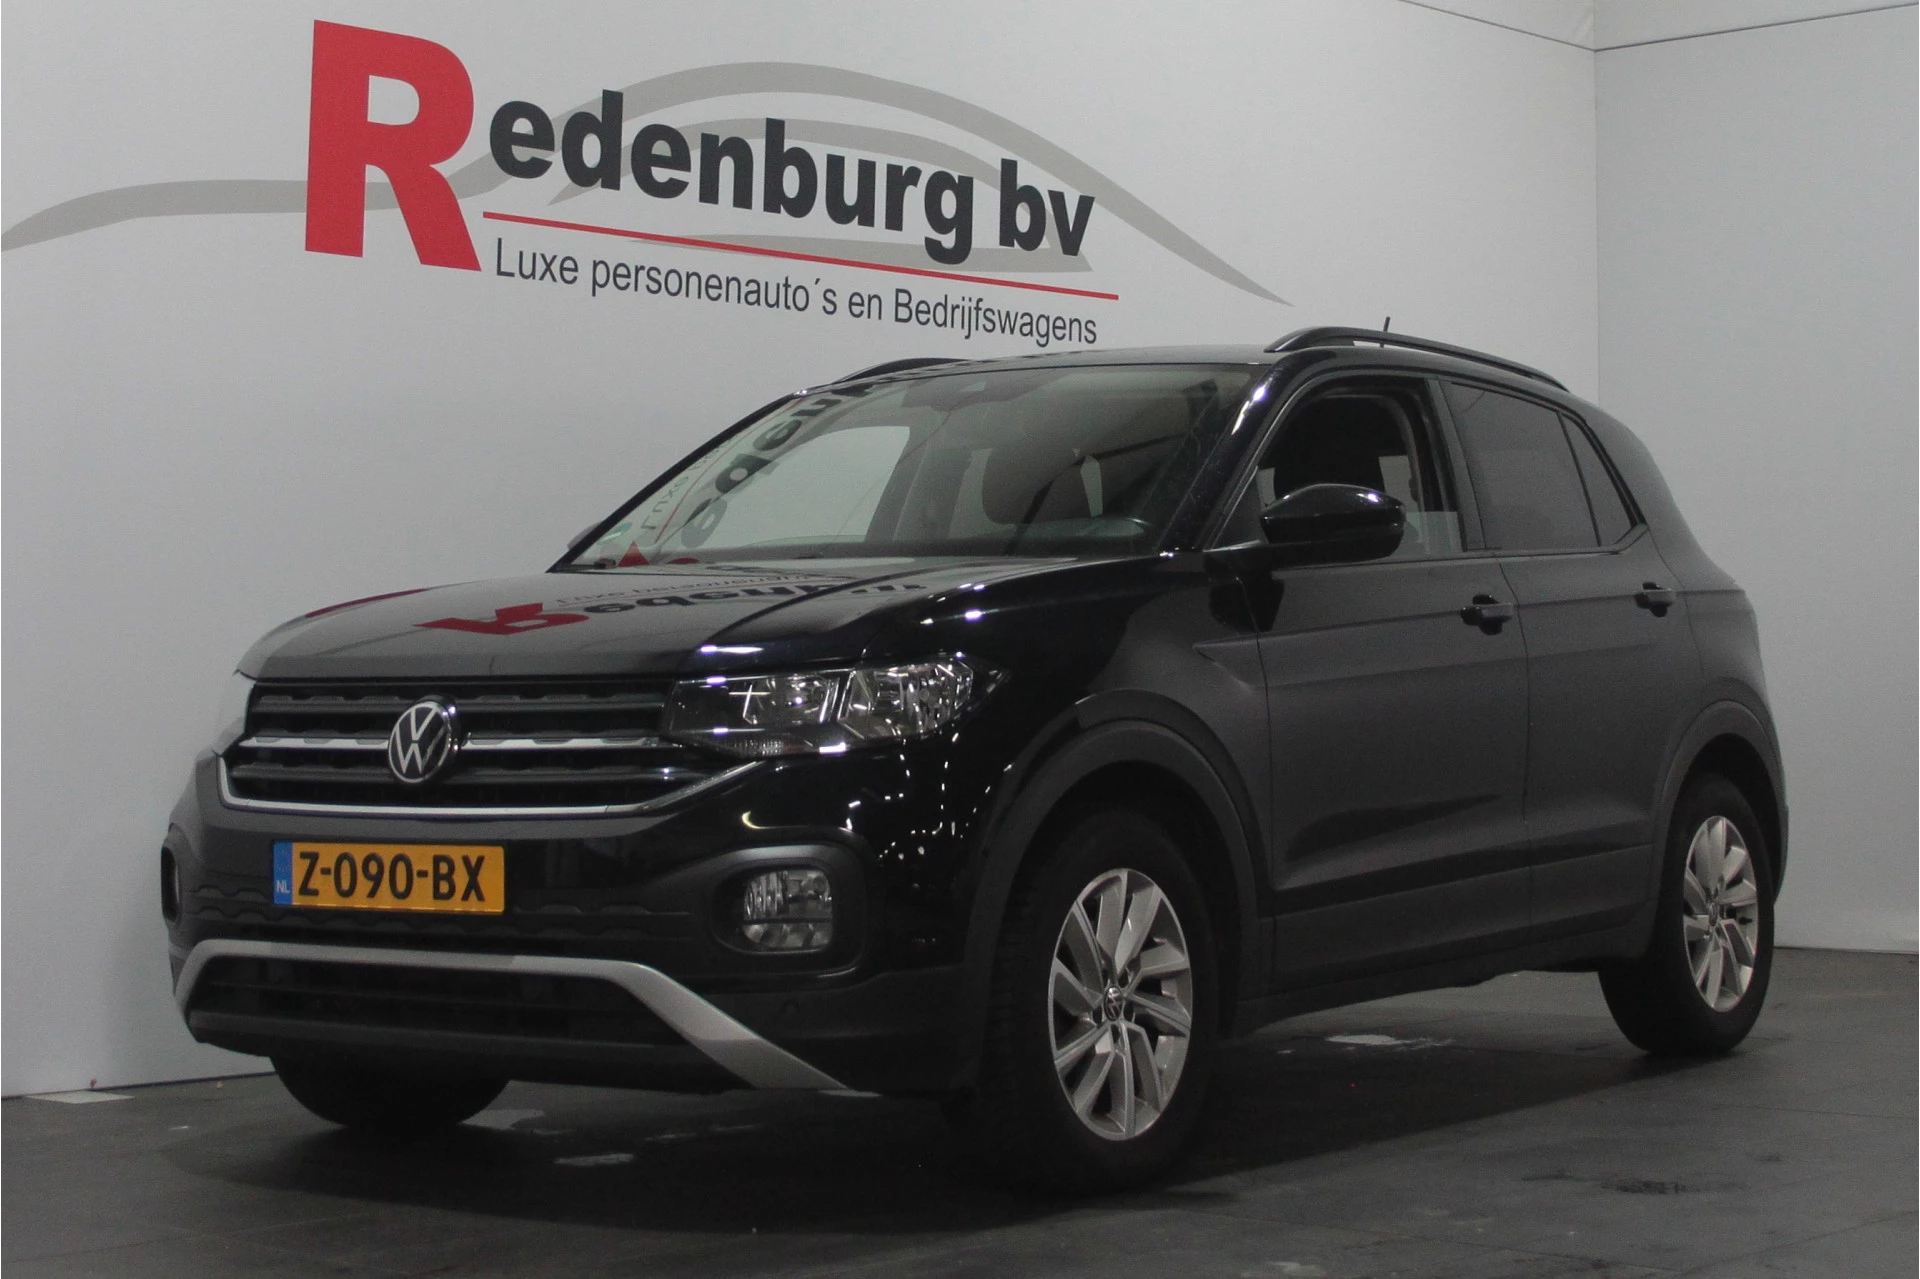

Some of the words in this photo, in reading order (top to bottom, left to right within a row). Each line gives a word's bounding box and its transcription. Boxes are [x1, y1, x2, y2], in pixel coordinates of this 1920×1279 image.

[306, 20, 973, 271] Redenburg
[1000, 159, 1095, 256] bv
[497, 238, 578, 284] Luxe
[849, 292, 882, 320] en
[895, 289, 1096, 347] Bedrijfswagens
[276, 879, 290, 893] NL
[298, 851, 486, 902] Z-090-BX
